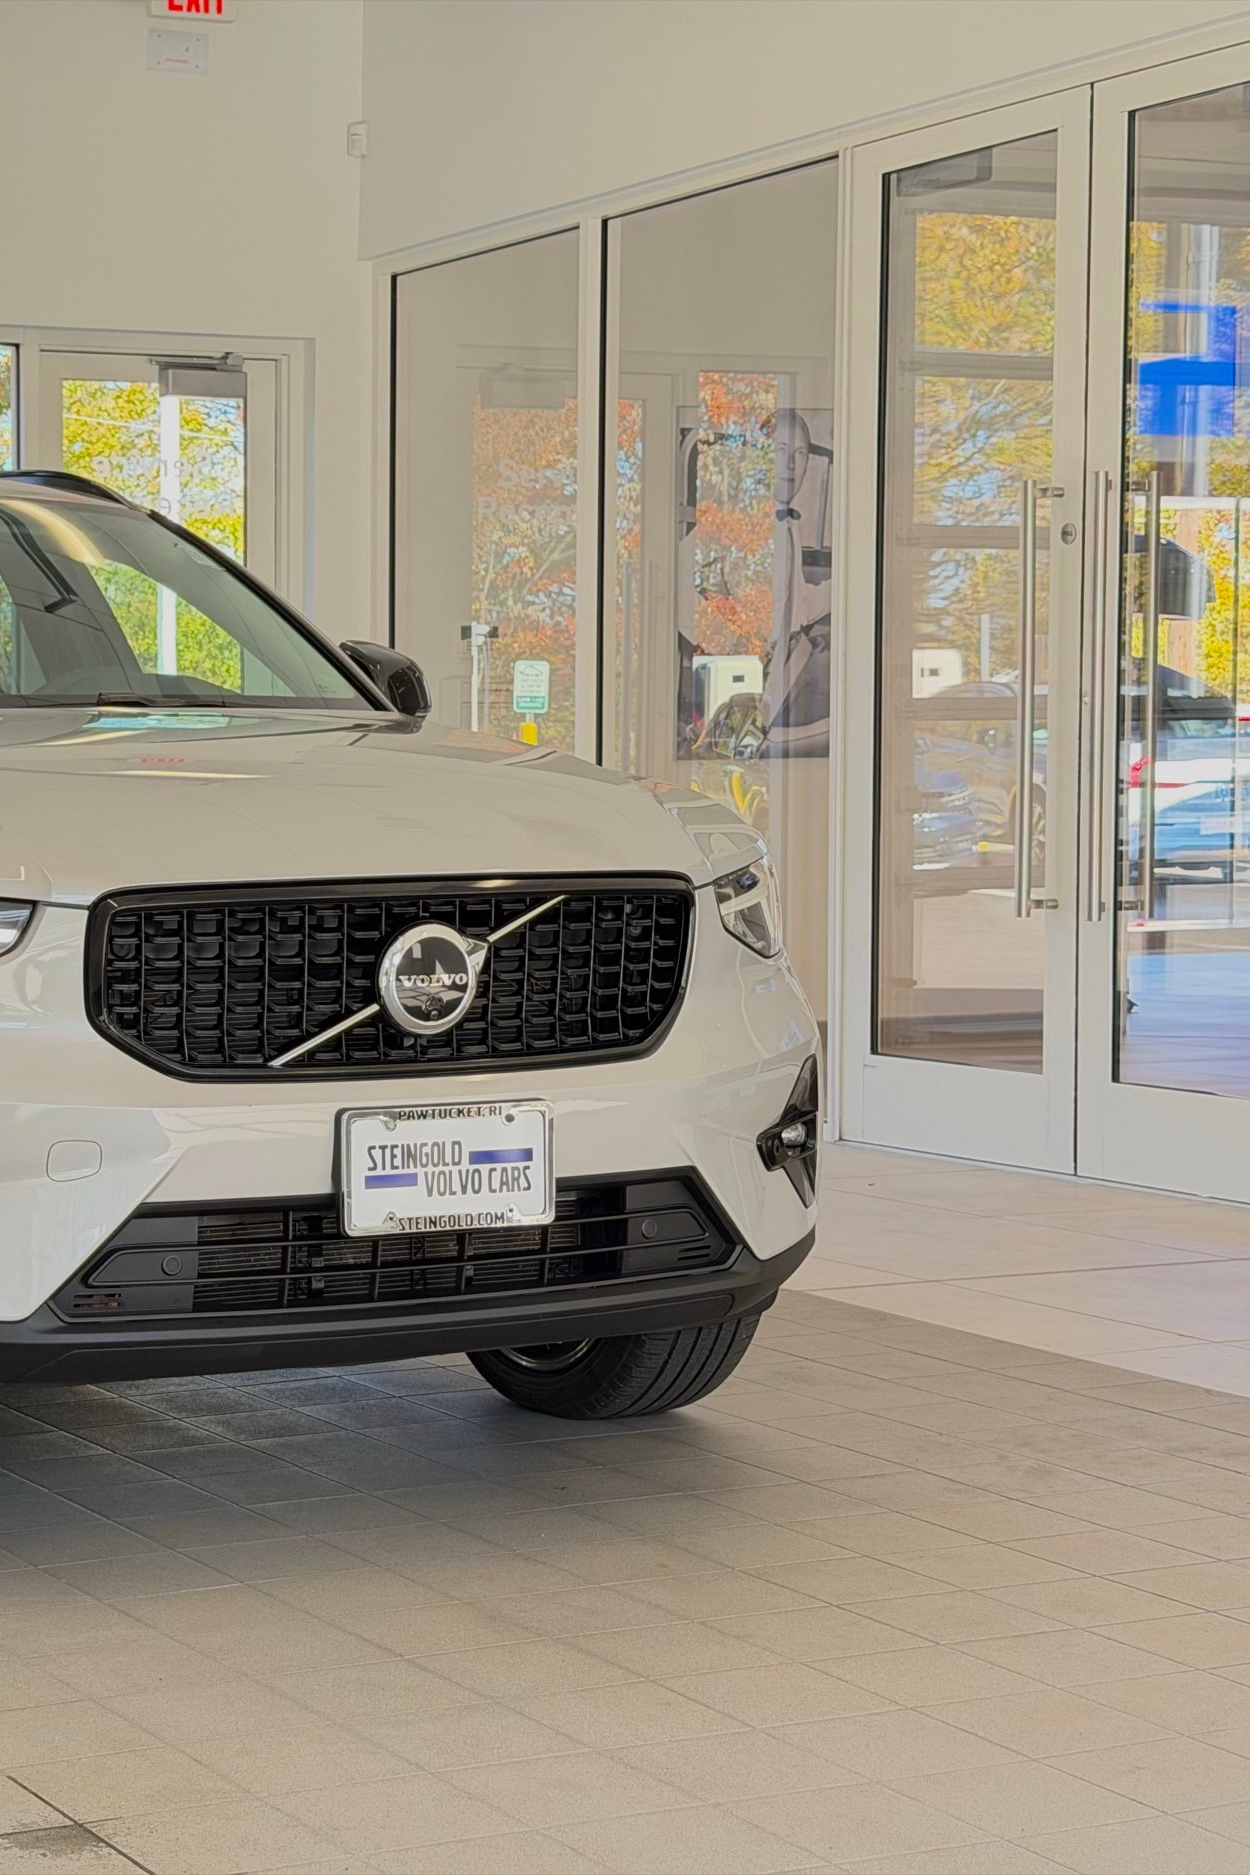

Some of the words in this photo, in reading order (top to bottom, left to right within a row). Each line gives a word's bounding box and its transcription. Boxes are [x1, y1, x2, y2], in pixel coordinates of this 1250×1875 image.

[399, 973, 468, 987] VOLVO
[488, 1105, 503, 1116] RI
[367, 1140, 462, 1172] STEINGOLD
[424, 1168, 482, 1198] VOLVO
[488, 1166, 532, 1193] CARS
[398, 1211, 505, 1232] STEINGOLD.COM
